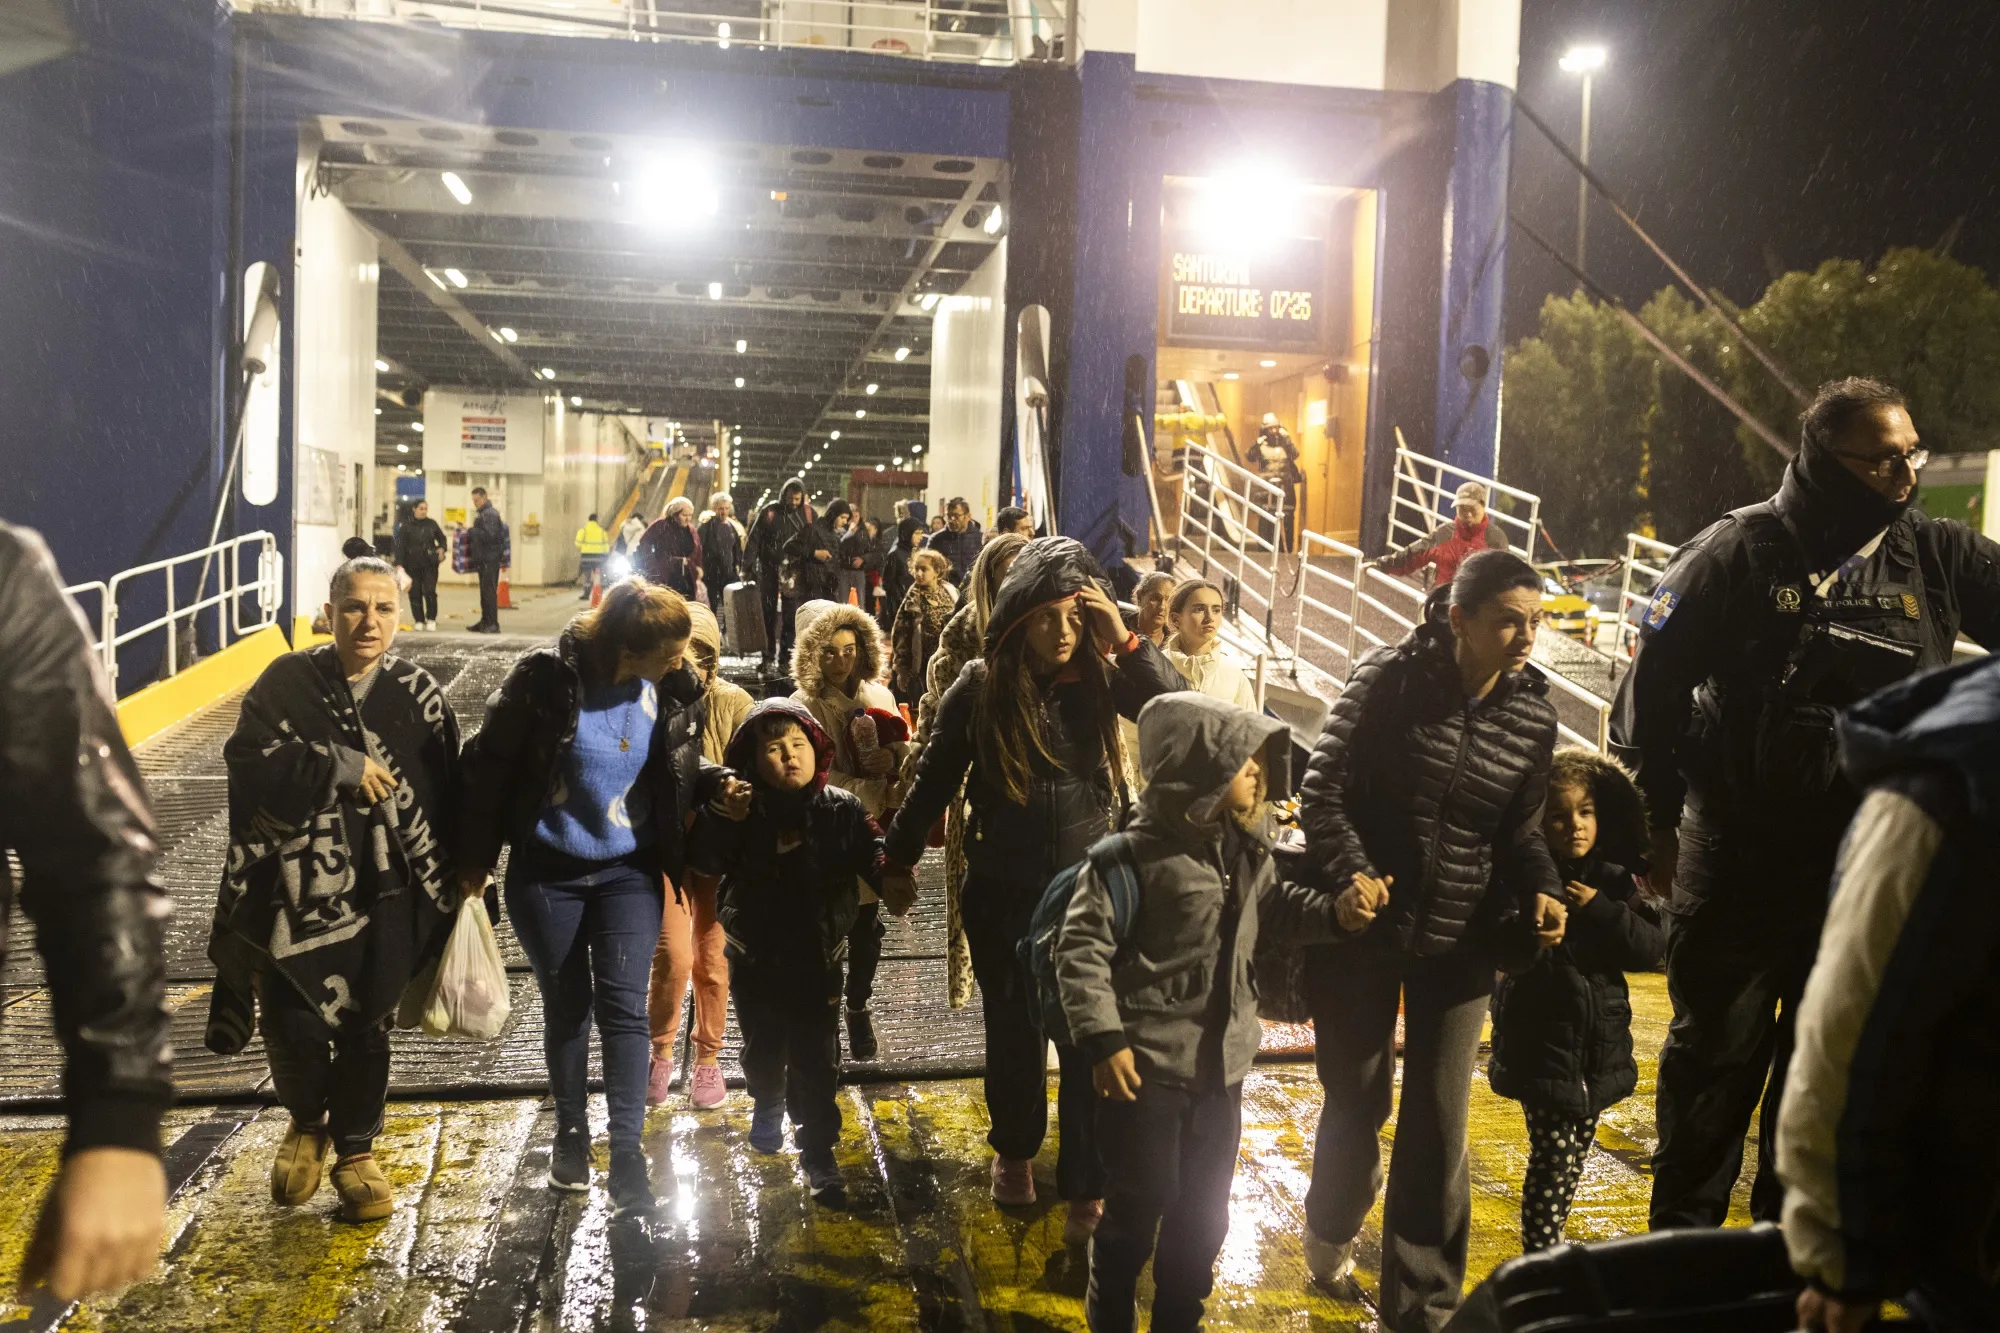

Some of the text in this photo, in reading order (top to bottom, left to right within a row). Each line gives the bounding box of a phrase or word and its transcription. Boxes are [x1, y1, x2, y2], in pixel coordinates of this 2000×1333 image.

[1178, 285, 1312, 321] DEPARTURE: 07:25
[1836, 598, 1870, 607] POLICE
